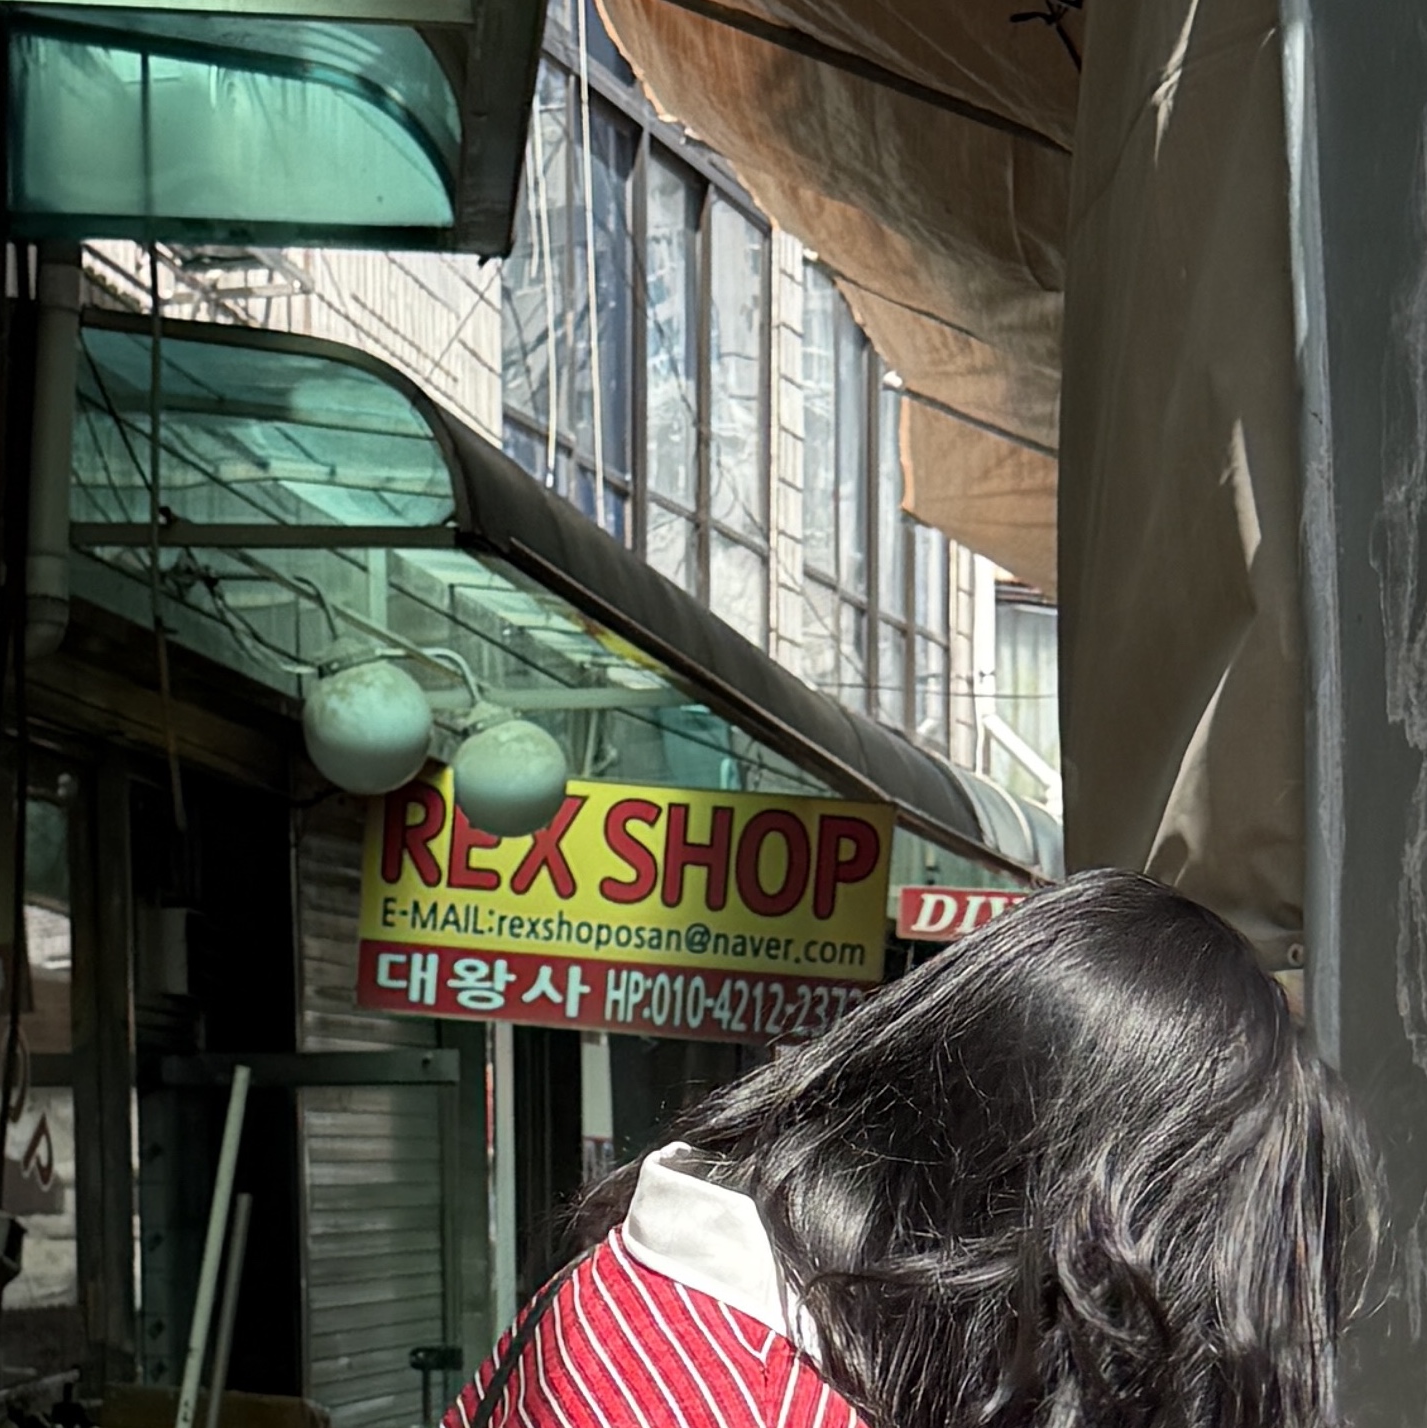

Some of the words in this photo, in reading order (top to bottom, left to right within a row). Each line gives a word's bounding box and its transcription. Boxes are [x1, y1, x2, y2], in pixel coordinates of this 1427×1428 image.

[380, 783, 589, 899] REX
[599, 798, 880, 920] SHOP
[377, 952, 592, 1019] 대왕사
